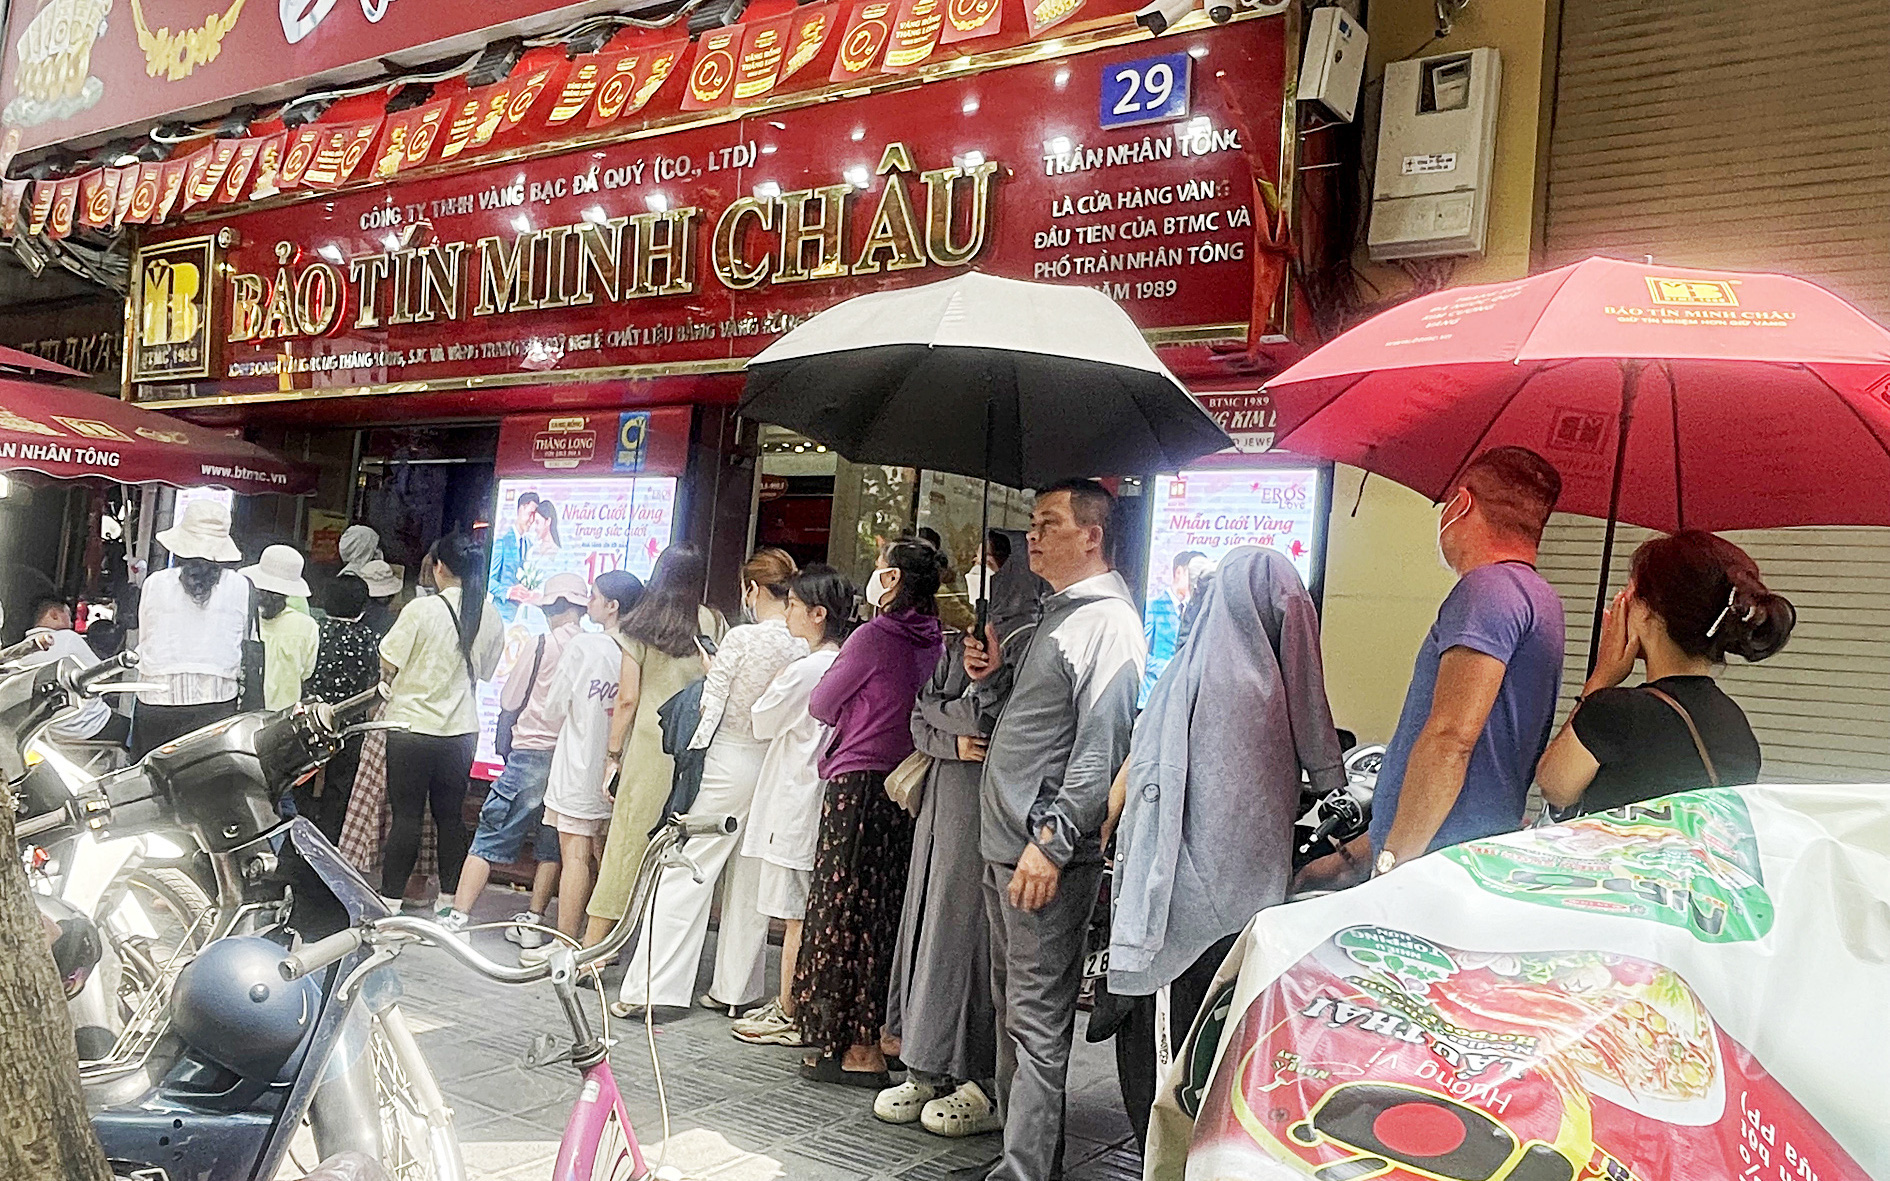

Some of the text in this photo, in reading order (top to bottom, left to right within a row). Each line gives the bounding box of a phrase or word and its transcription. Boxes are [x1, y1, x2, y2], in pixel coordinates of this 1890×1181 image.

[1112, 63, 1175, 115] 29
[1106, 135, 1173, 168] NHÂN
[405, 202, 427, 223] TY
[478, 184, 526, 211] VÀNG
[530, 176, 568, 206] BẠC
[603, 157, 645, 190] QUÝ
[708, 140, 759, 172] LTD)
[1052, 194, 1075, 218] LÀ
[1077, 189, 1113, 214] CỬA
[1117, 184, 1174, 210] HÀNG
[1033, 226, 1071, 252] ĐẦU
[1119, 216, 1158, 241] CỦA
[1163, 211, 1220, 236] BTMC
[1227, 205, 1252, 229] VÀ
[228, 142, 999, 343] BẢO TÍN MINH CHÂU
[1034, 253, 1072, 280] PHỐ
[1128, 244, 1183, 270] NHÂN
[1187, 240, 1245, 266] TÔNG
[1094, 279, 1178, 302] ĂM 1989
[1604, 305, 1797, 320] BẢO TÍN MINH CHÂU
[1209, 396, 1271, 408] BTMC 1989
[1231, 410, 1266, 429] KIM
[20, 443, 72, 464] NHÂN
[75, 446, 121, 467] TÔNG
[568, 437, 594, 450] LONG
[201, 461, 288, 485] www.btmc.vn
[1253, 513, 1295, 535] Vàng
[1186, 532, 1221, 547] Trang
